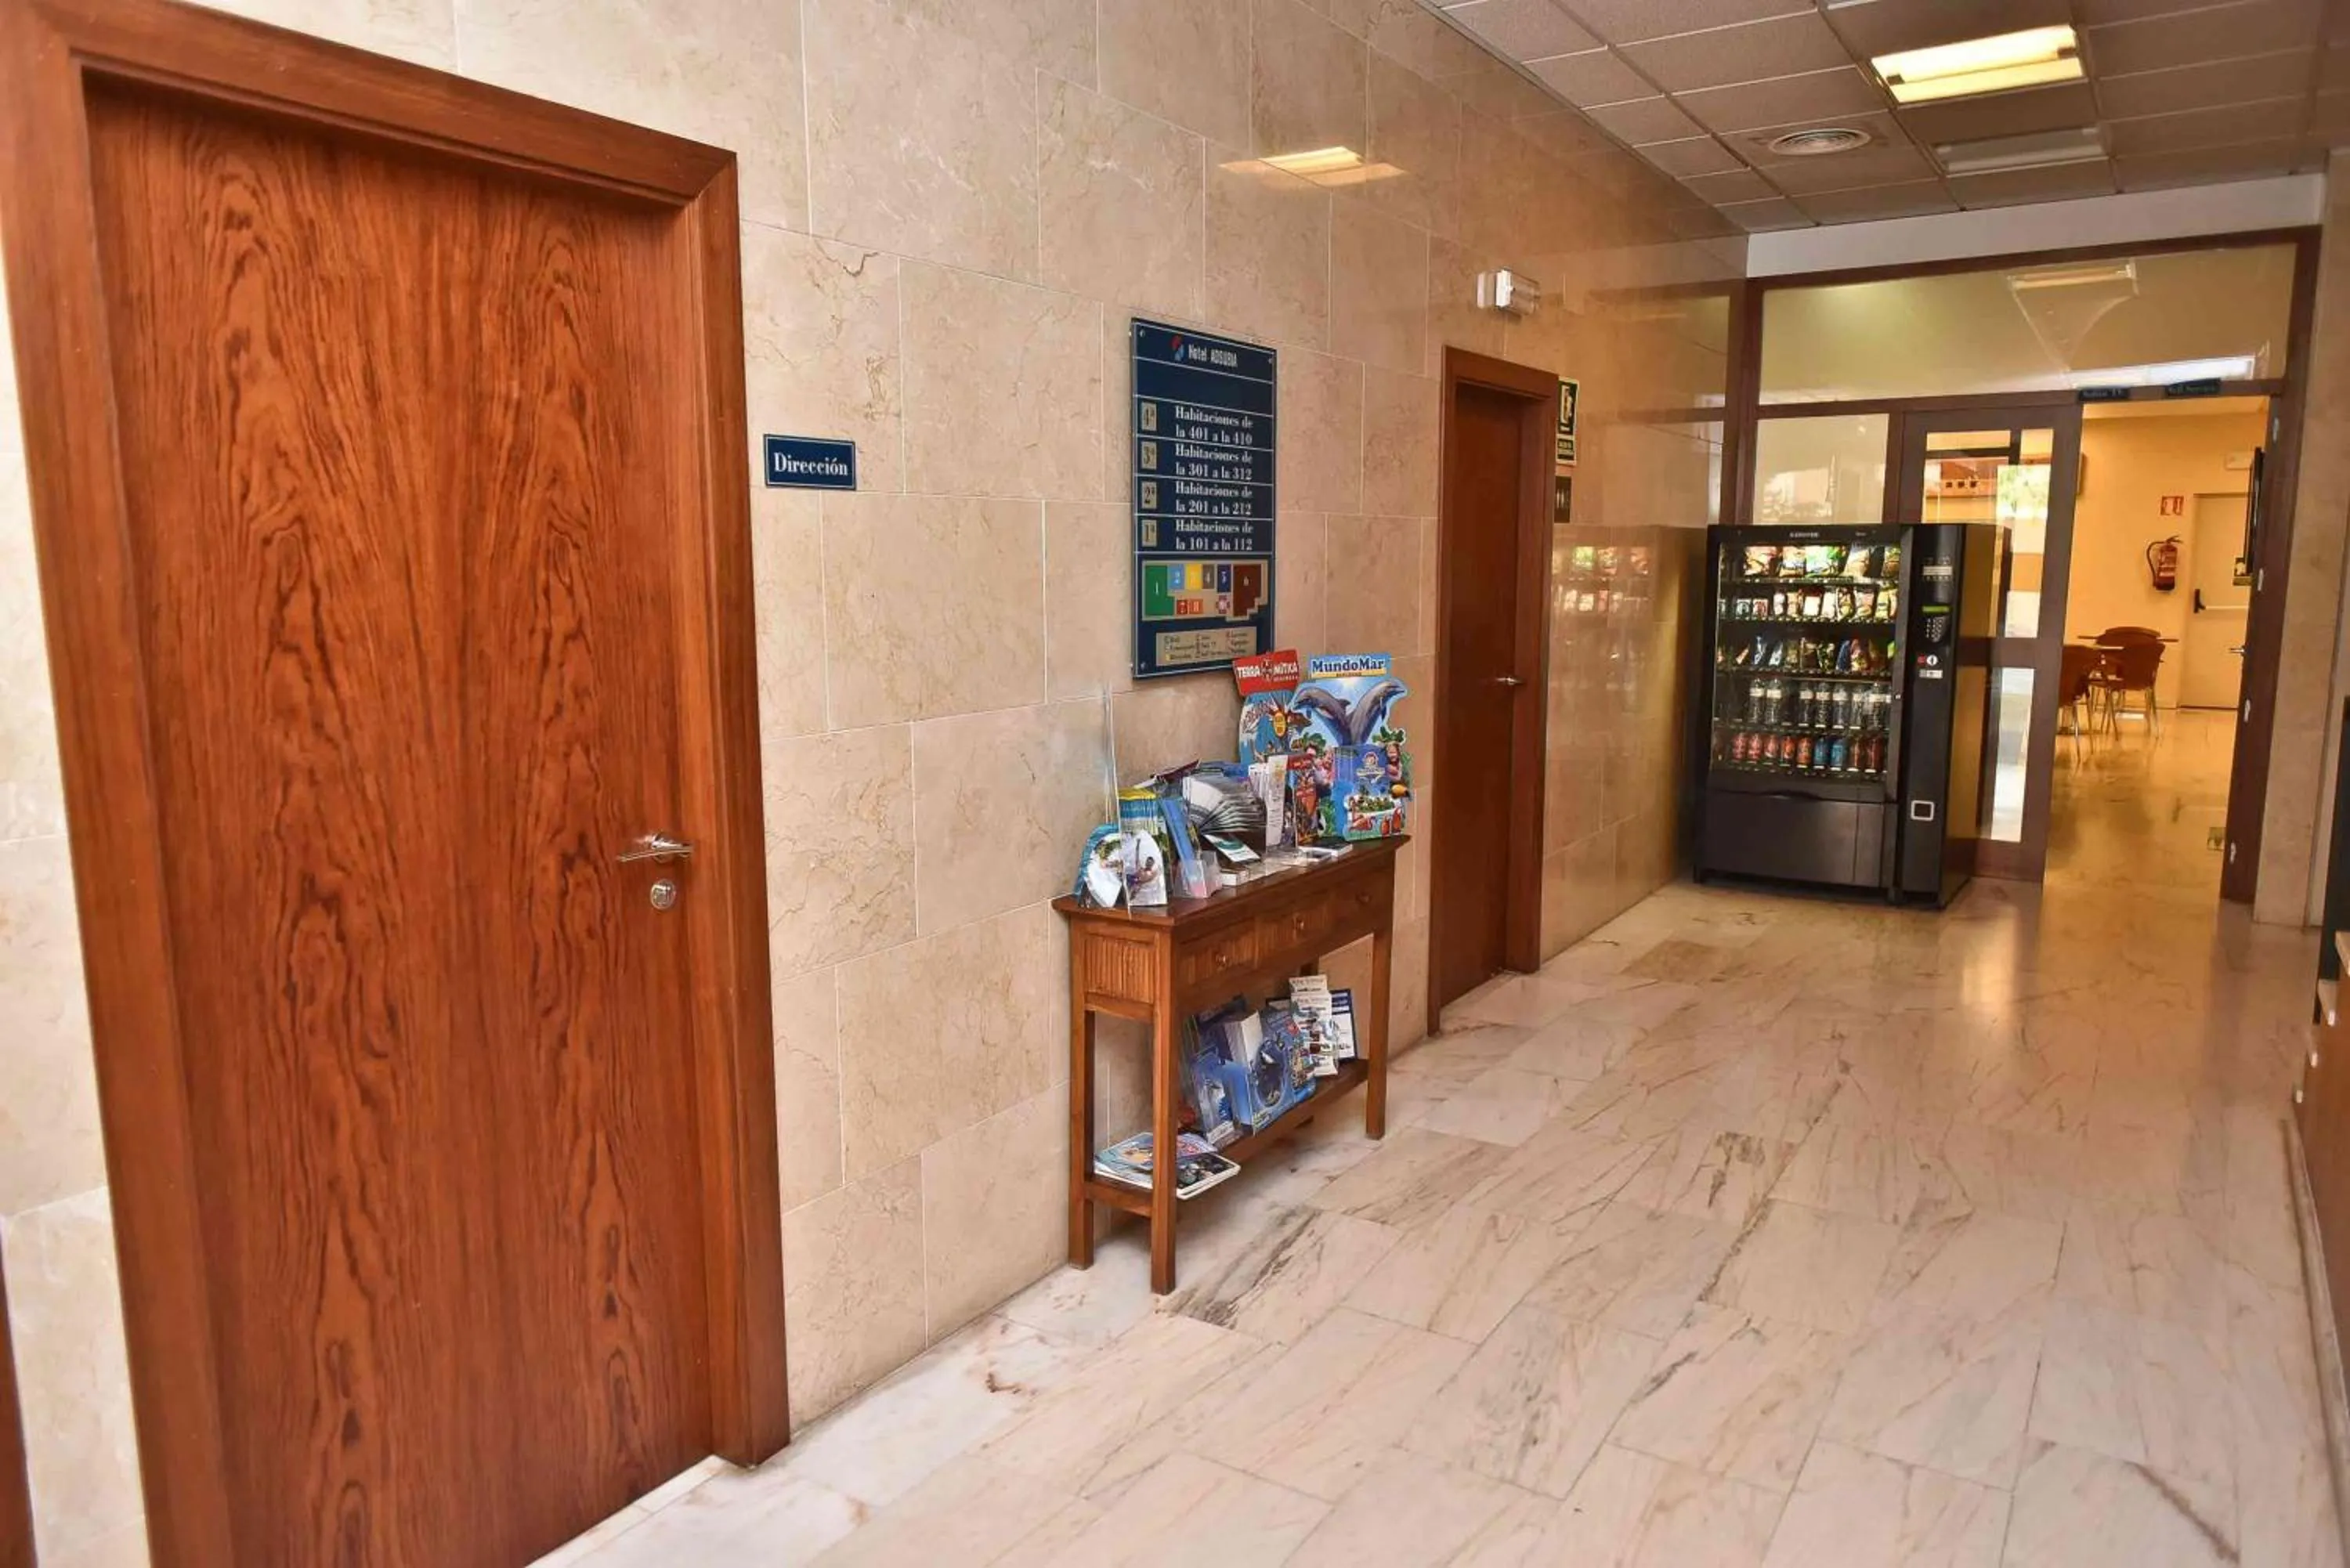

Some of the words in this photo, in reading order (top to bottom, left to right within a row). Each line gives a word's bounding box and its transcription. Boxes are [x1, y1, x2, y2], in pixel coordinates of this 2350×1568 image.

[1188, 344, 1207, 362] Hotel
[1175, 405, 1239, 426] Habitaciones
[1242, 415, 1253, 428] de
[1175, 424, 1185, 438] la
[1188, 425, 1209, 441] 401
[1221, 429, 1231, 443] la
[1232, 431, 1253, 446] 410
[1175, 443, 1239, 462] Habitaciones
[1242, 450, 1253, 464] de
[774, 452, 848, 476] Dirección
[1175, 462, 1185, 475] la
[1188, 463, 1209, 477] 301
[1221, 465, 1231, 479] la
[1232, 466, 1253, 480] 312
[1175, 480, 1239, 497] Habitaciones
[1241, 486, 1253, 498] de
[1176, 499, 1185, 513] la
[1188, 500, 1209, 514] 201
[1221, 501, 1230, 515] la
[1232, 502, 1252, 515] 212
[1176, 518, 1240, 533] Habitaciones
[1242, 520, 1253, 533] de
[1176, 536, 1185, 551] la
[1190, 537, 1209, 551] 101
[1221, 537, 1231, 551] la
[1234, 538, 1253, 551] 112
[1237, 665, 1260, 679] TERRA
[1312, 658, 1385, 673] MundoMar
